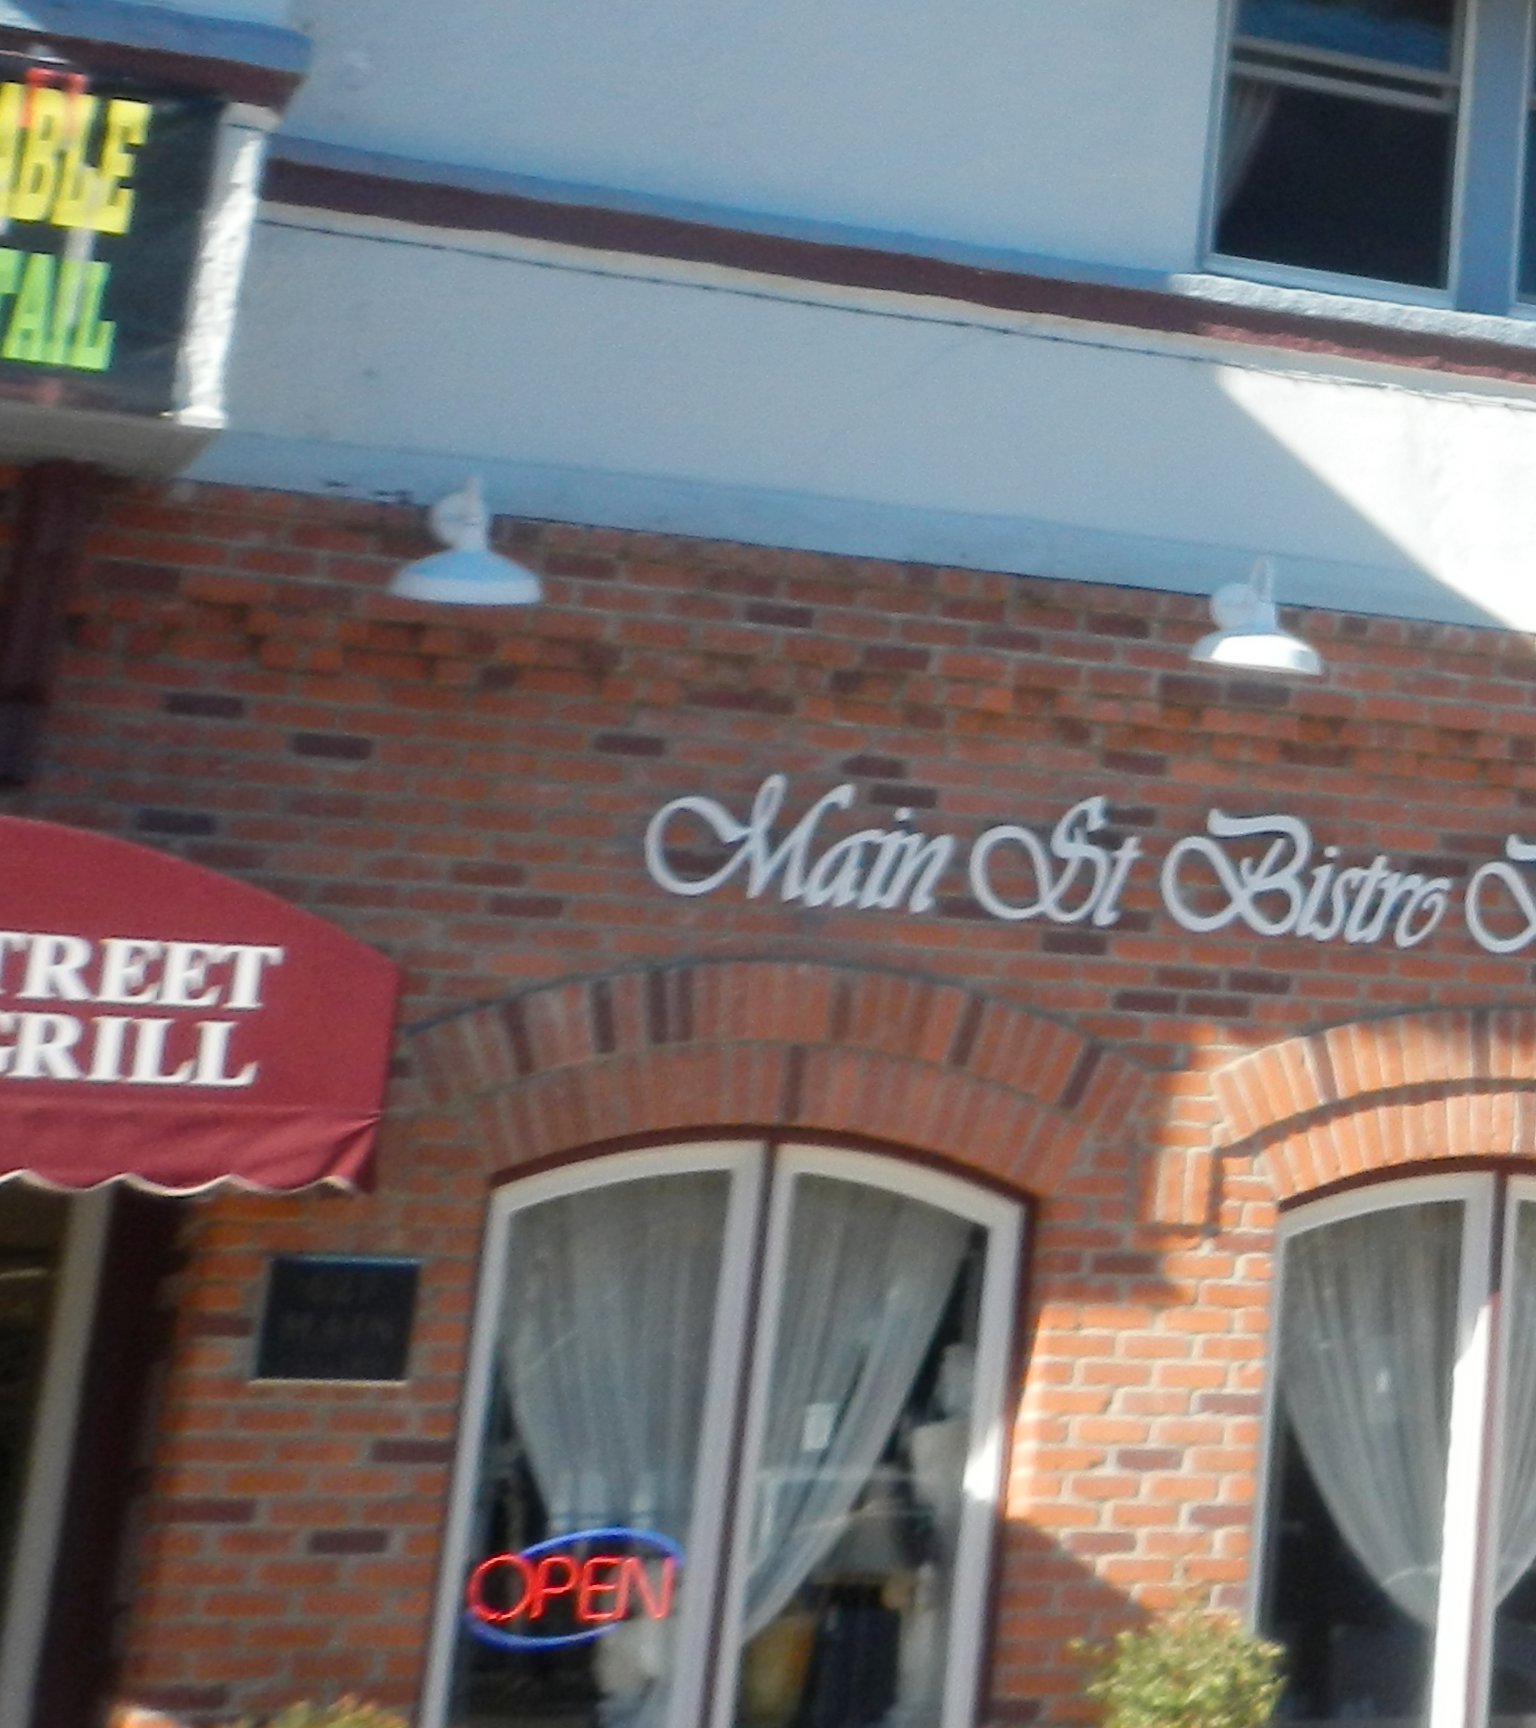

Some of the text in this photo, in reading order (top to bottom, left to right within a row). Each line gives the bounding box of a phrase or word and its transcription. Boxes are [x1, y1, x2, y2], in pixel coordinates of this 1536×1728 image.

[645, 774, 953, 913] Main
[970, 796, 1142, 927] St
[1160, 809, 1450, 947] Bistro
[465, 1553, 676, 1623] OPEN
